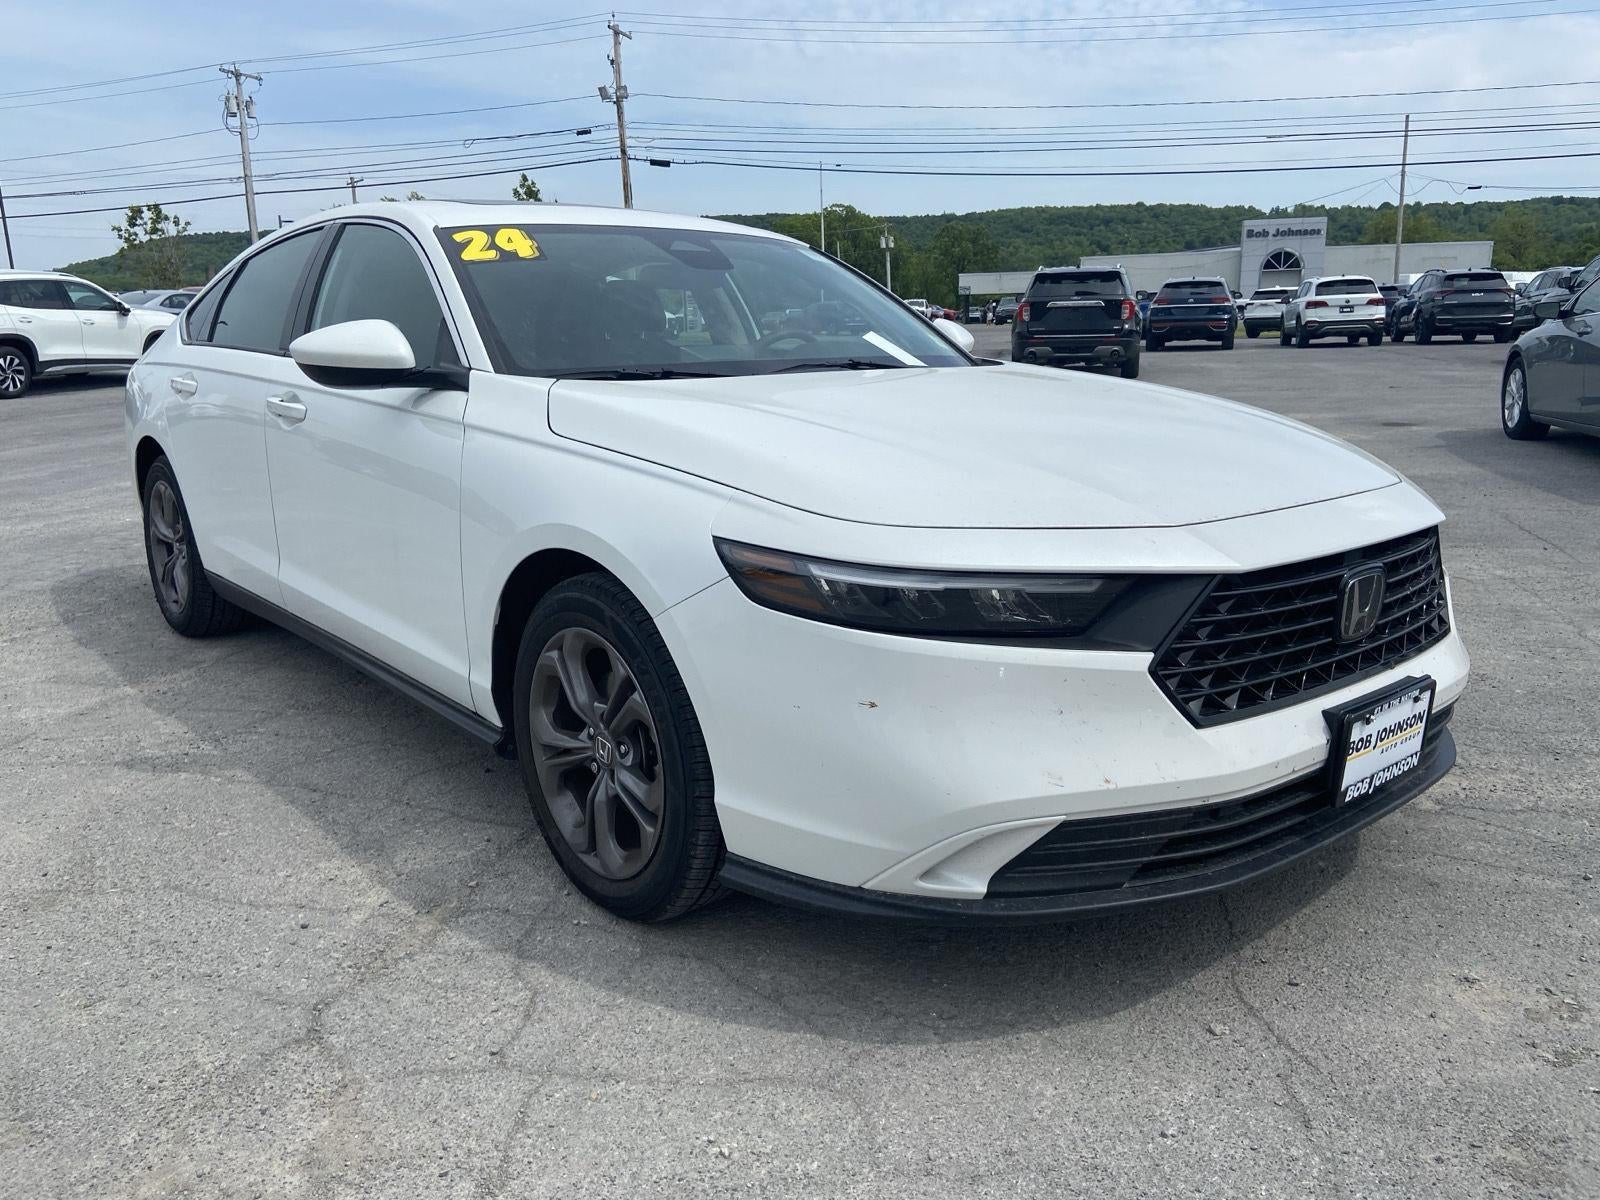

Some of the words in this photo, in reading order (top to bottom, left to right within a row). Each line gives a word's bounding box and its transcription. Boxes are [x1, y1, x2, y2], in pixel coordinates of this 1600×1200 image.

[452, 228, 540, 262] 24
[1246, 228, 1270, 239] Bob
[1272, 227, 1324, 238] Johnson
[1348, 733, 1373, 756] BOB
[1373, 709, 1427, 751] JOHNSON
[1380, 741, 1399, 755] AUTO
[1345, 777, 1371, 803] BOB
[1369, 752, 1421, 794] JOHNSON
